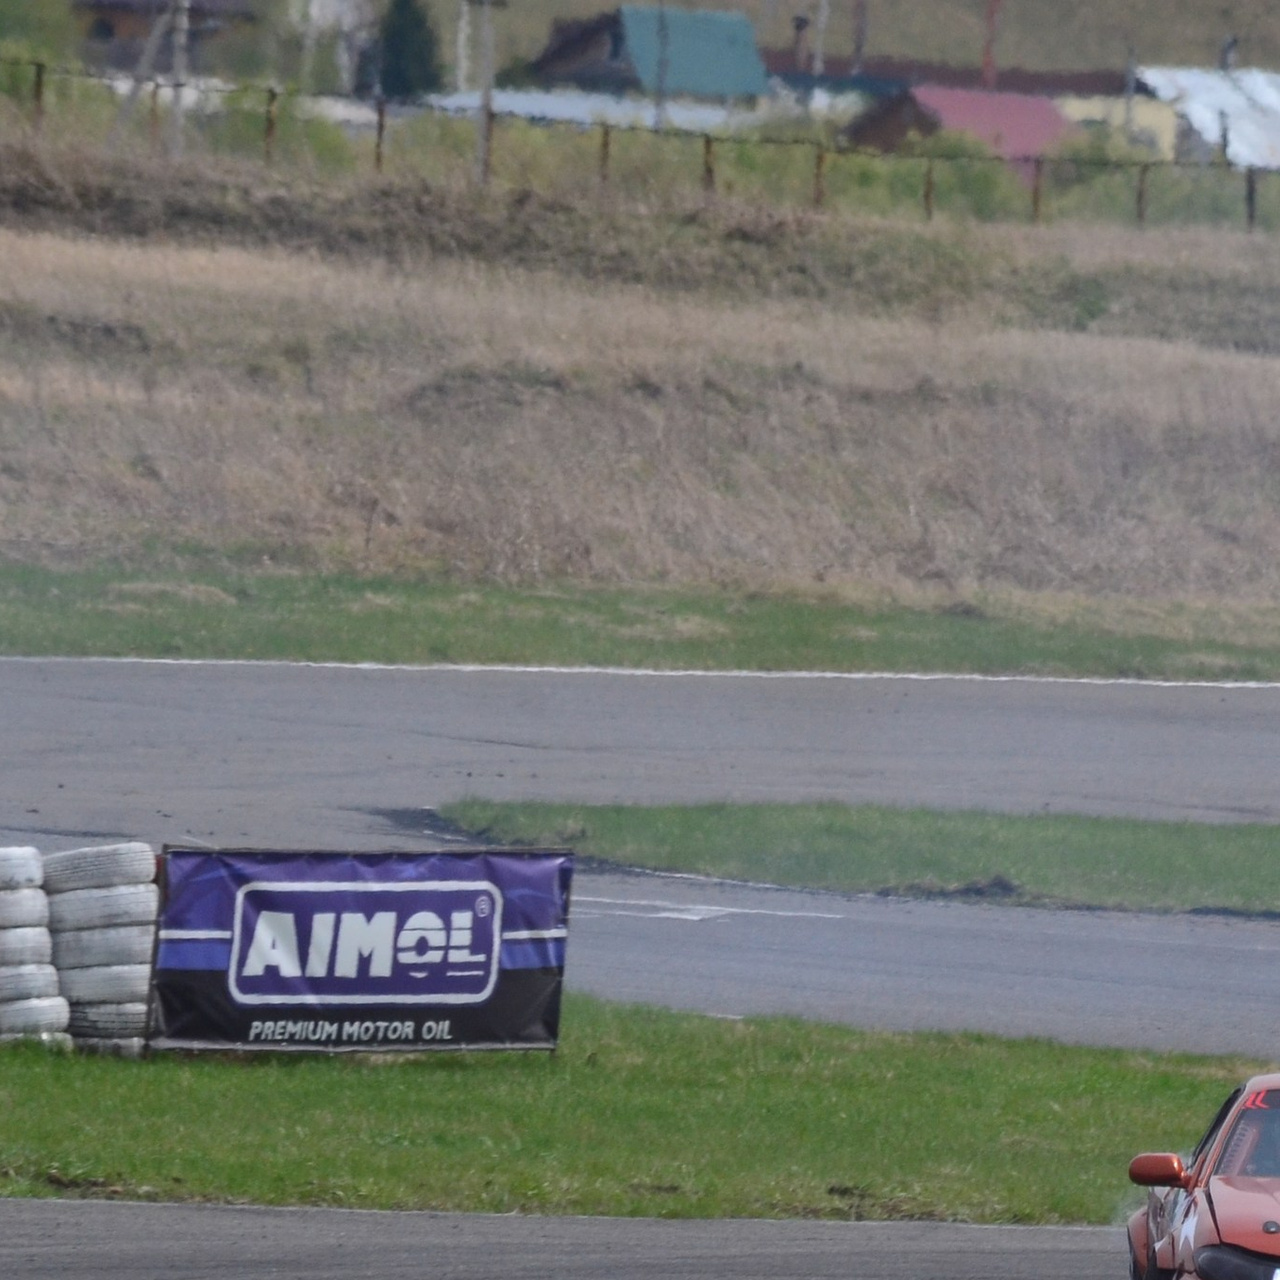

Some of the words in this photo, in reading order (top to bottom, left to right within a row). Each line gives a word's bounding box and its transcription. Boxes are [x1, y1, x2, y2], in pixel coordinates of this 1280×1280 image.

[241, 911, 487, 978] AIMOL
[249, 1020, 338, 1041] PREMIUM
[342, 1020, 415, 1041] MOTOR
[422, 1020, 453, 1040] OIL
